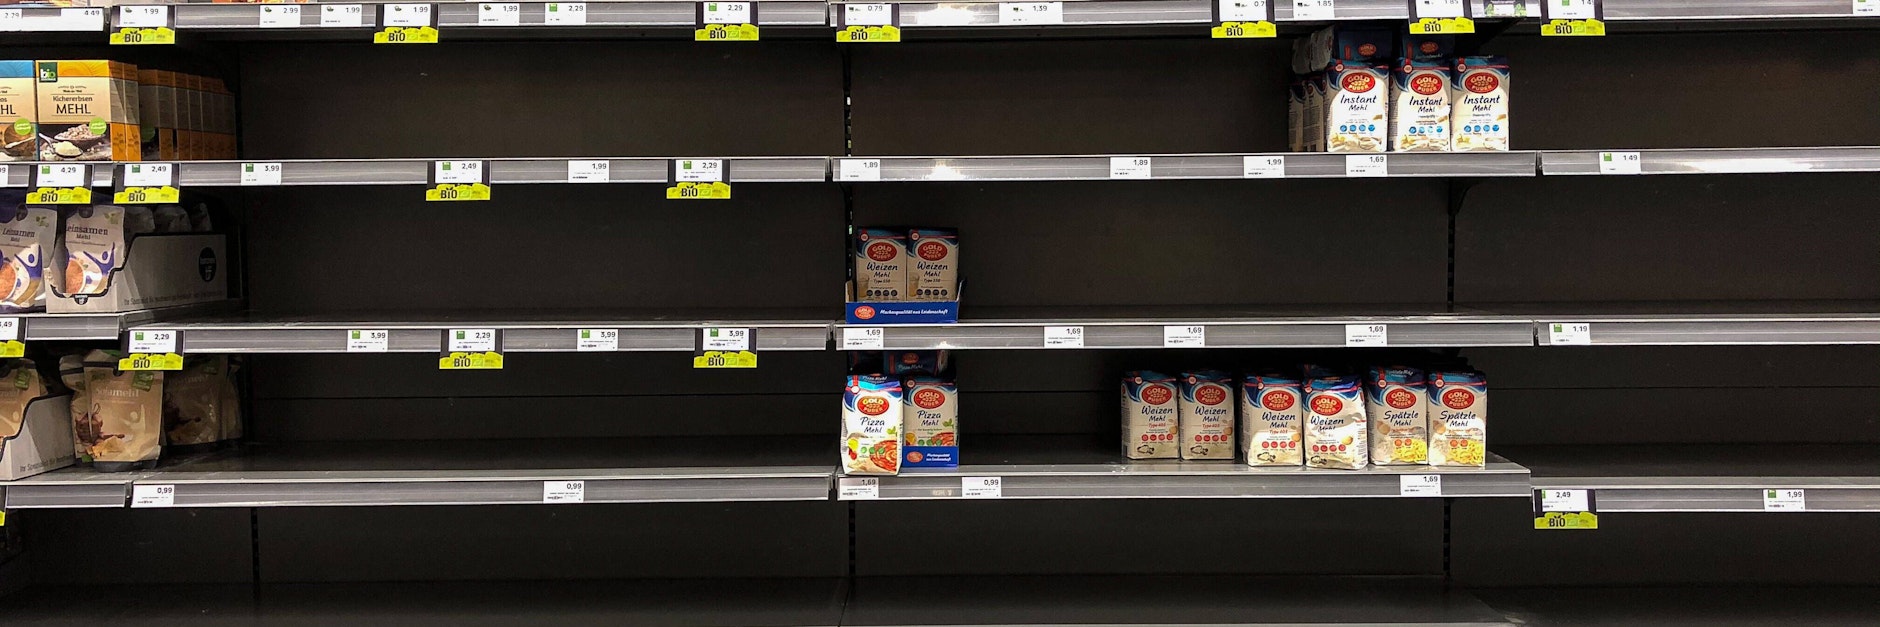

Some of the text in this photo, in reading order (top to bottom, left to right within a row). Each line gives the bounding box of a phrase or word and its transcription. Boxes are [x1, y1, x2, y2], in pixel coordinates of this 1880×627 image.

[1340, 95, 1377, 104] Instant
[1410, 96, 1442, 106] Instant
[1464, 95, 1500, 104] Instant
[56, 104, 91, 114] MEHL
[2, 228, 35, 238] Leinsamen
[866, 262, 898, 270] Weizen
[917, 262, 948, 270] Weizen
[917, 410, 942, 419] Pizza
[1142, 406, 1172, 414] Weizen
[1194, 406, 1226, 414] Weizen
[1262, 412, 1296, 421] Weizen
[1310, 416, 1344, 424] Weizen
[1384, 410, 1418, 422] Spätzle
[1440, 410, 1476, 422] Spätzle
[860, 416, 884, 426] Pizza
